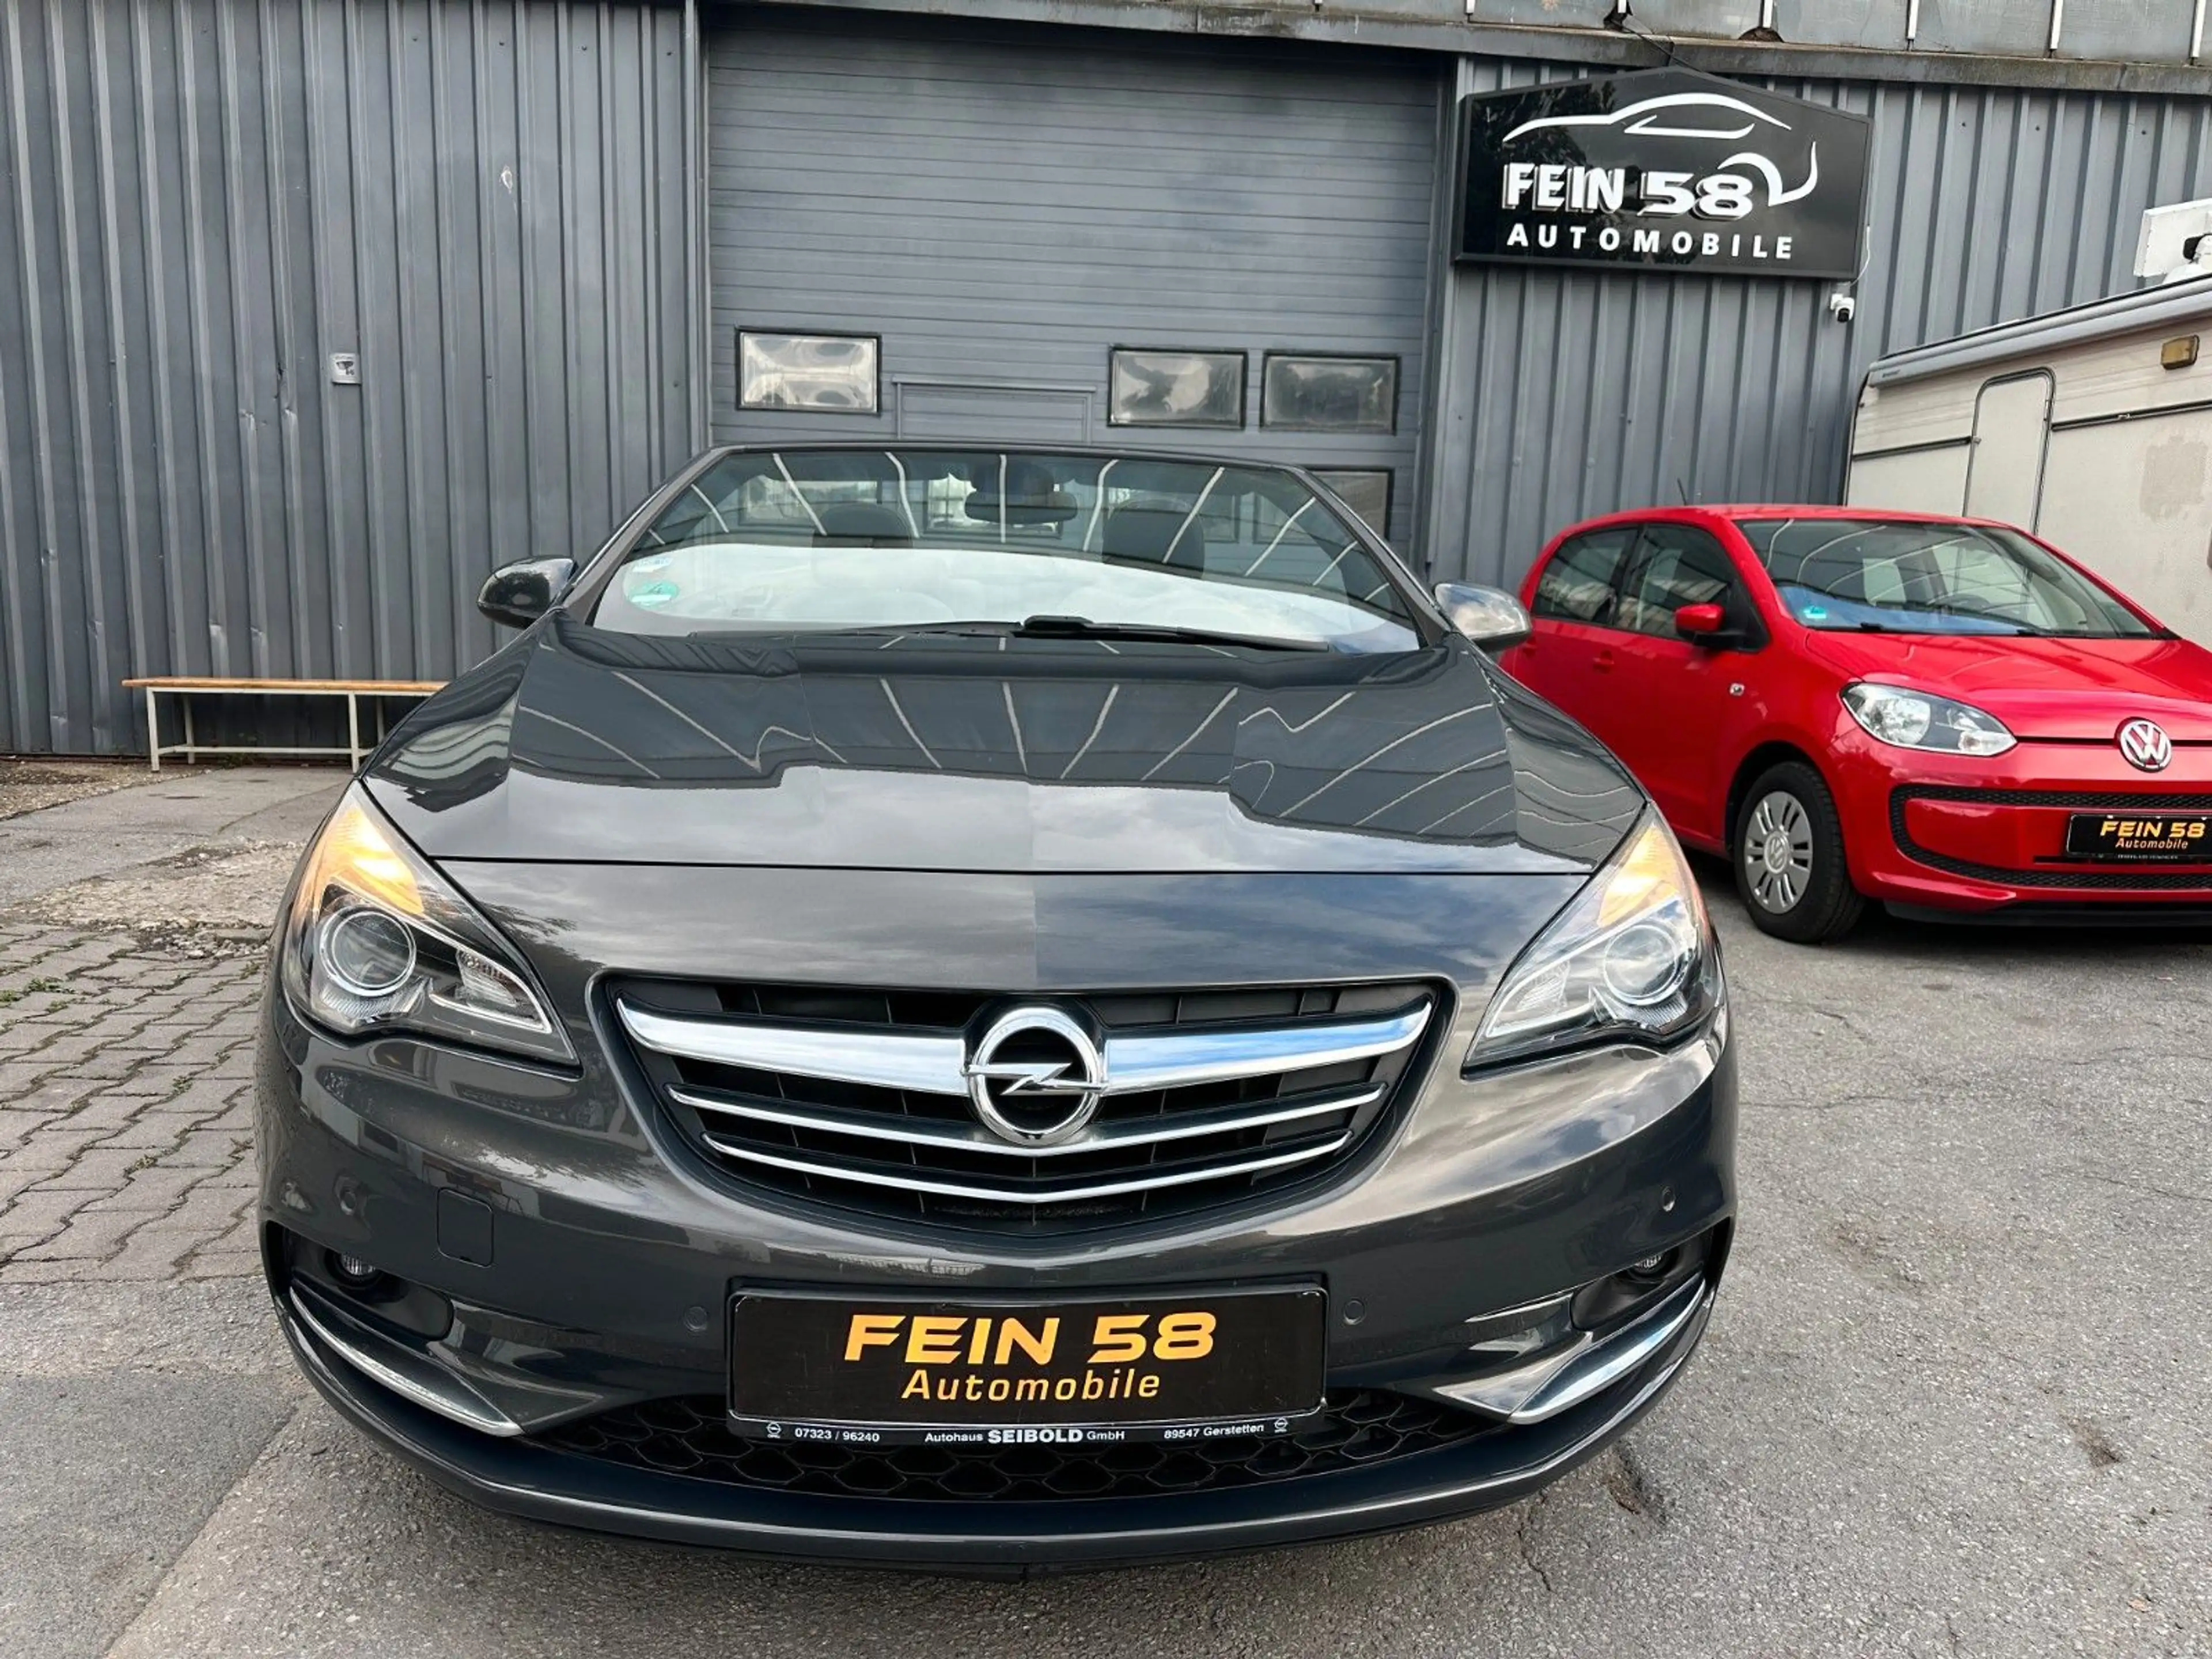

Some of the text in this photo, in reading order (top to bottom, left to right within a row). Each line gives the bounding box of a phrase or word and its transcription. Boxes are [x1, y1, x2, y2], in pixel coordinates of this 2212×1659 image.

[1502, 162, 1753, 220] FEIN 58
[1507, 224, 1792, 259] AUTOMOBILE
[2100, 821, 2206, 838] FEIN 58
[2115, 838, 2188, 849] Automobile
[844, 1312, 1217, 1365] FEIN 58
[901, 1368, 1160, 1401] Automobile
[794, 1427, 880, 1442] 07323 / 96240
[924, 1429, 1125, 1444] Autohaus SEIBOLD GmbH
[1164, 1424, 1265, 1439] 89547 Gerstetten
